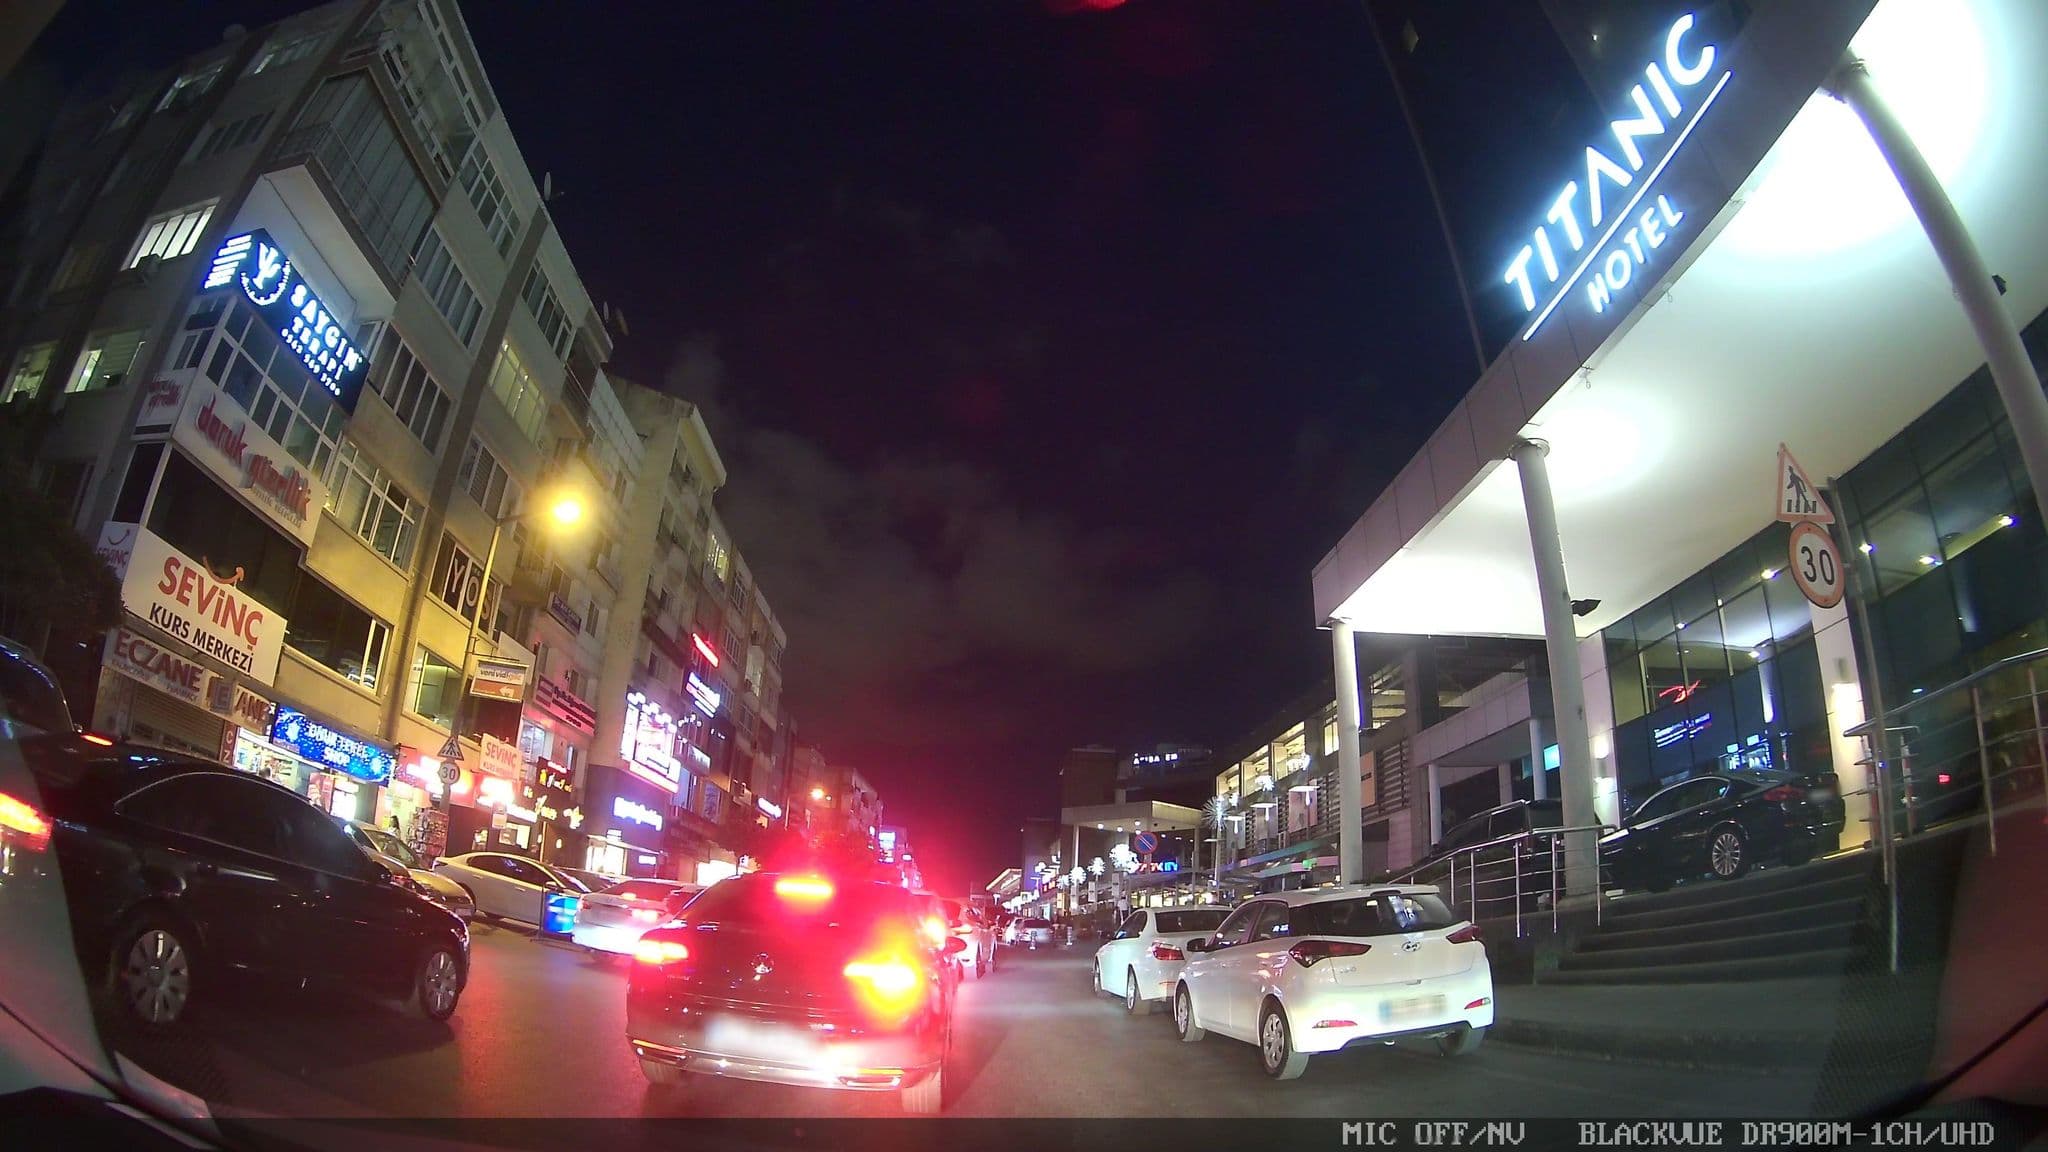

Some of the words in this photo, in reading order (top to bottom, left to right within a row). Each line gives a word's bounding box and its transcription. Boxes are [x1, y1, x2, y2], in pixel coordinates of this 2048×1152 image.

[1504, 13, 1716, 312] TITANIC
[1586, 194, 1684, 314] HOTEL
[291, 284, 361, 371] SAYGIN
[1800, 545, 1835, 586] 30
[115, 630, 205, 692] ECZANE
[149, 602, 191, 639] KURS
[193, 628, 254, 674] MERKEZİ
[441, 766, 457, 780] 30
